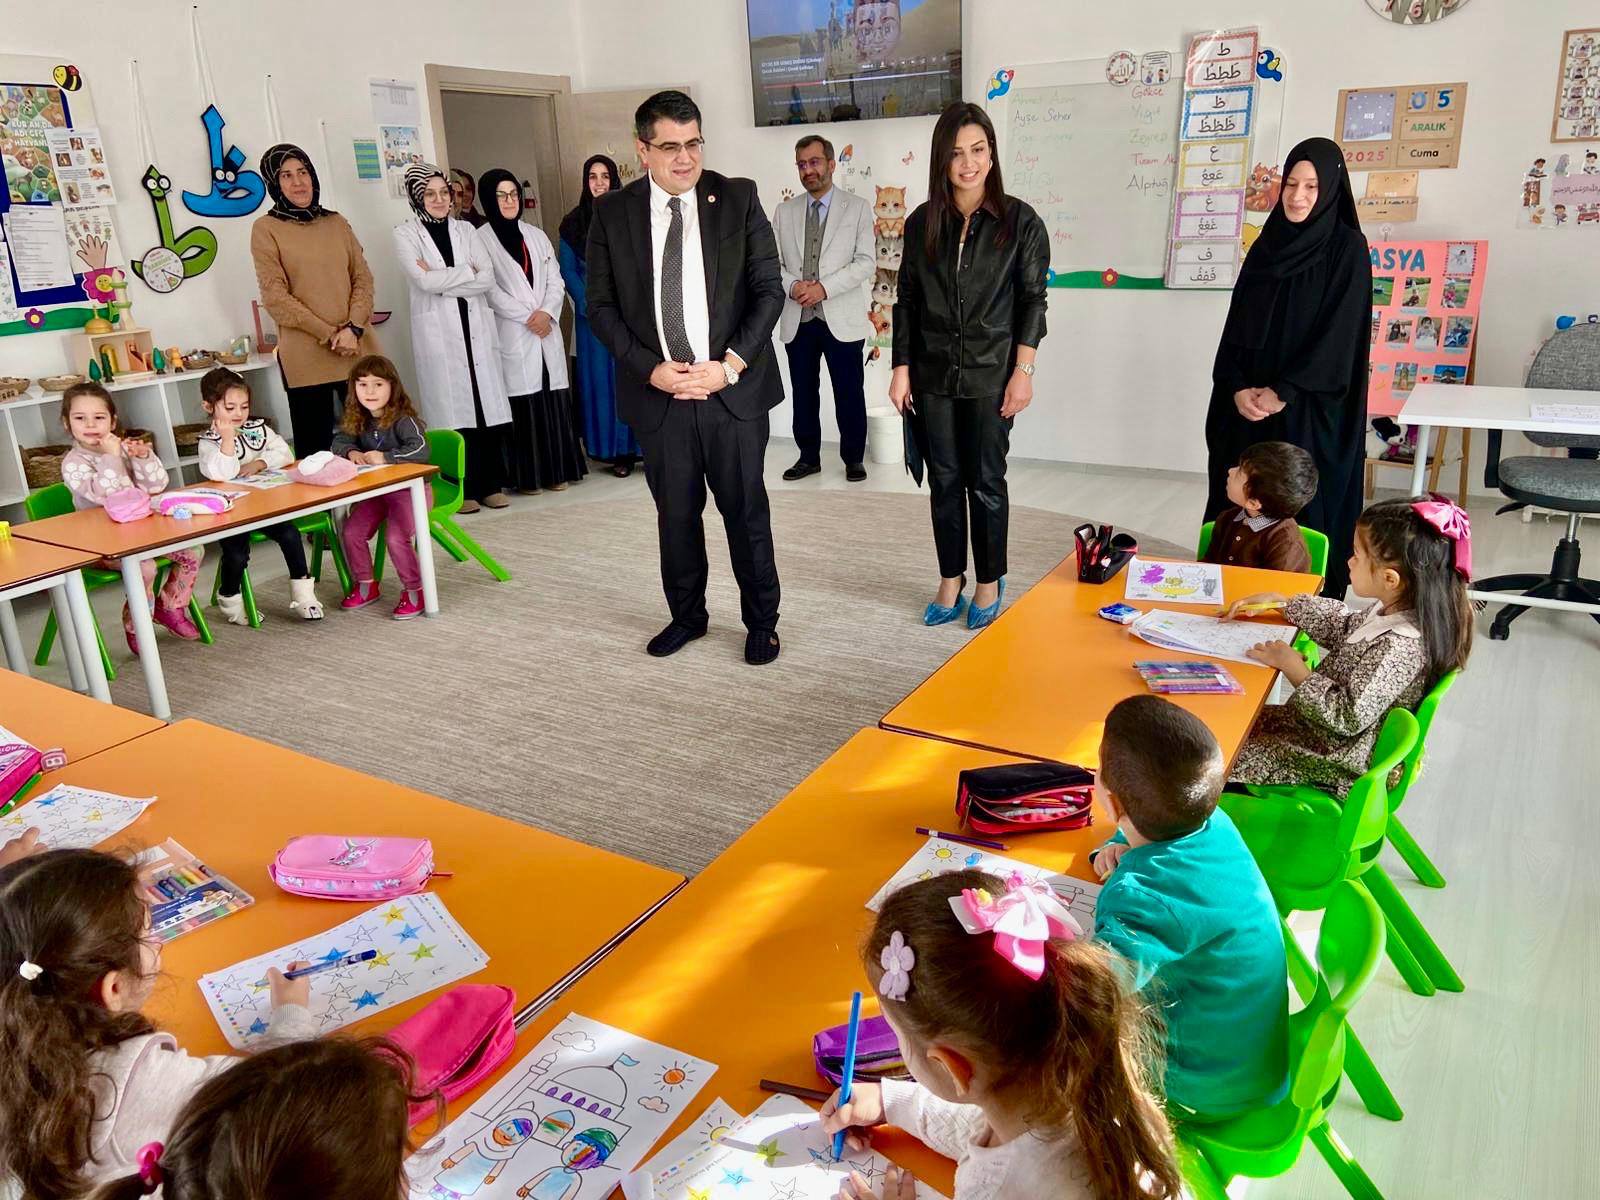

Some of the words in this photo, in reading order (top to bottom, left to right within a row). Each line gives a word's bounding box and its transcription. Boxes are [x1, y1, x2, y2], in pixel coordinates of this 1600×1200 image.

[1411, 1, 1423, 19] 6
[1217, 42, 1231, 56] ط
[1212, 95, 1226, 109] ظ
[1410, 121, 1447, 132] ARALIK
[1345, 151, 1386, 163] 2025
[1410, 148, 1440, 158] Cuma
[1198, 247, 1213, 261] ف
[1371, 247, 1426, 272] ASYA
